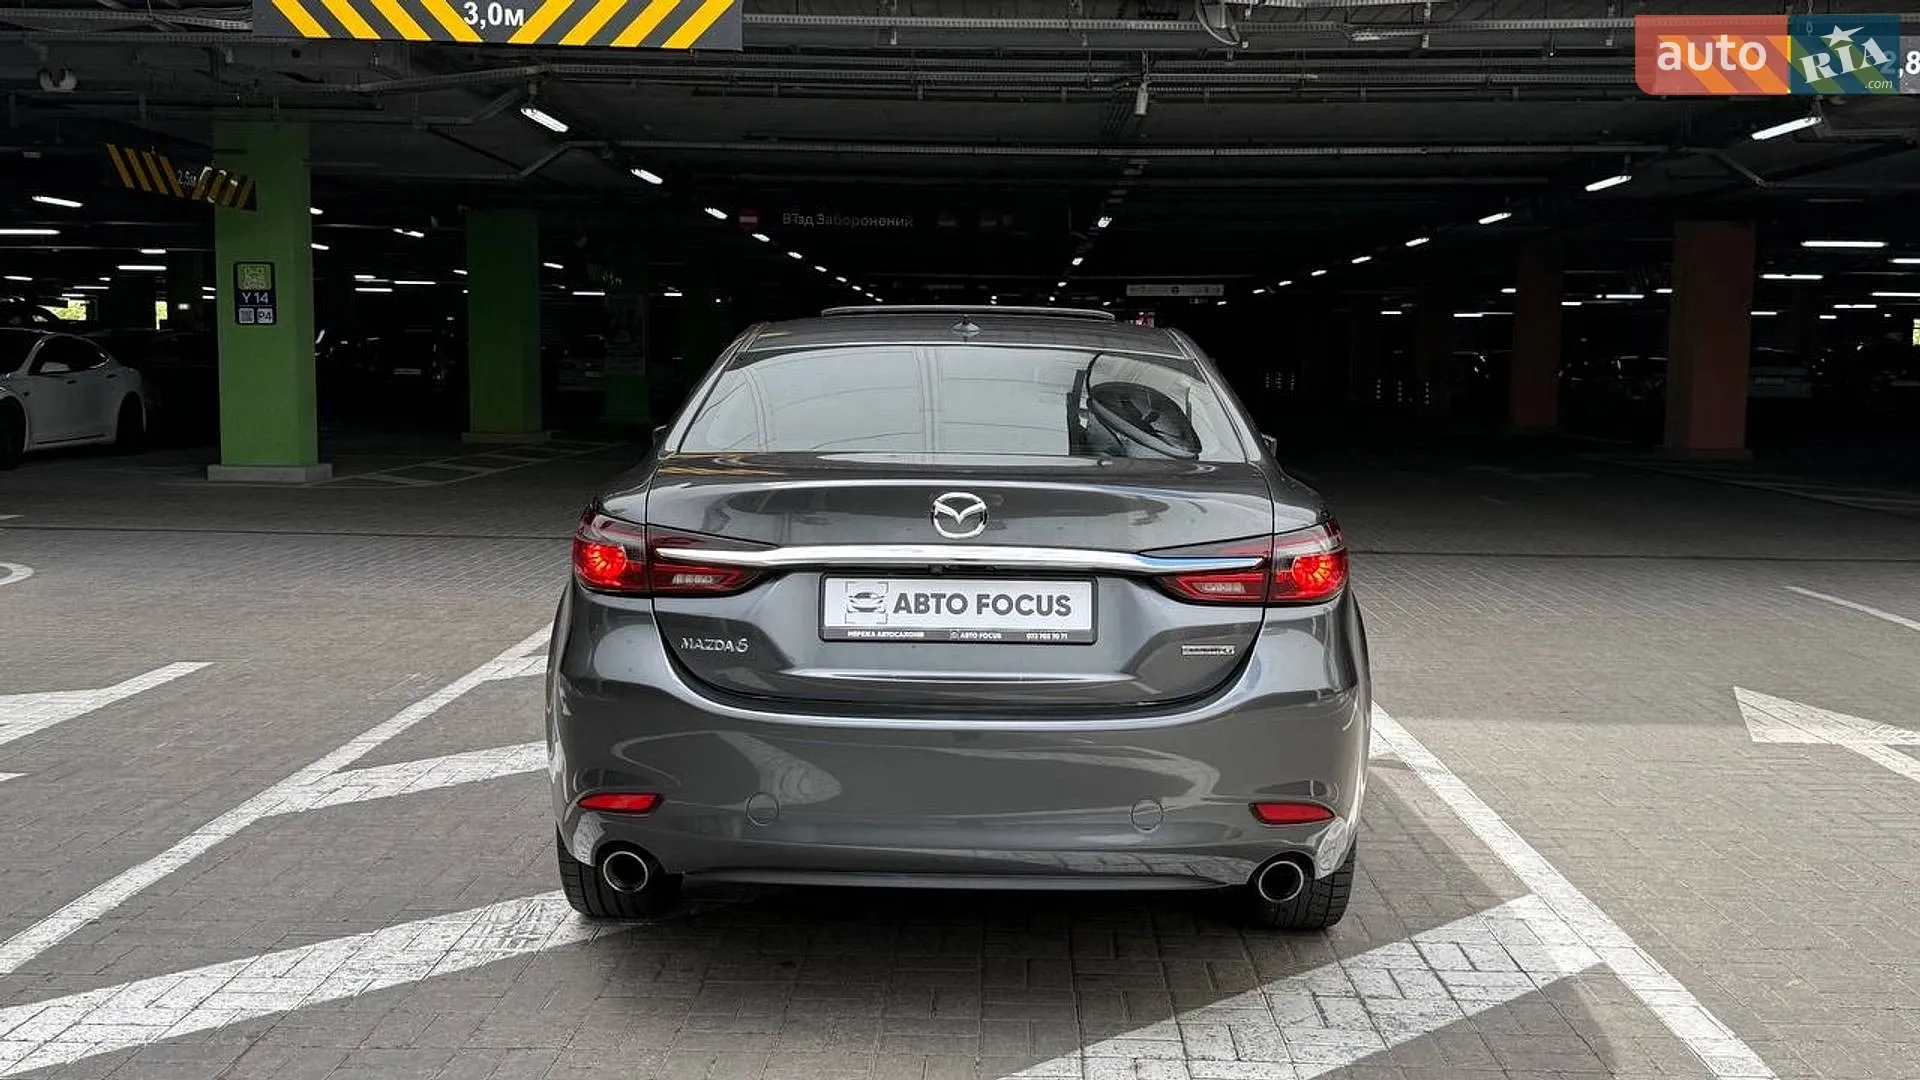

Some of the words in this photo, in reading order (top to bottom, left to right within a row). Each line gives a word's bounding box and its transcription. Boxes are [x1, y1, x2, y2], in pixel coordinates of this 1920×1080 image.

[463, 1, 525, 30] 3,0м
[241, 291, 251, 304] Y
[253, 291, 269, 305] 14
[976, 593, 1072, 617] FOCUS
[979, 632, 1002, 640] FOCUS
